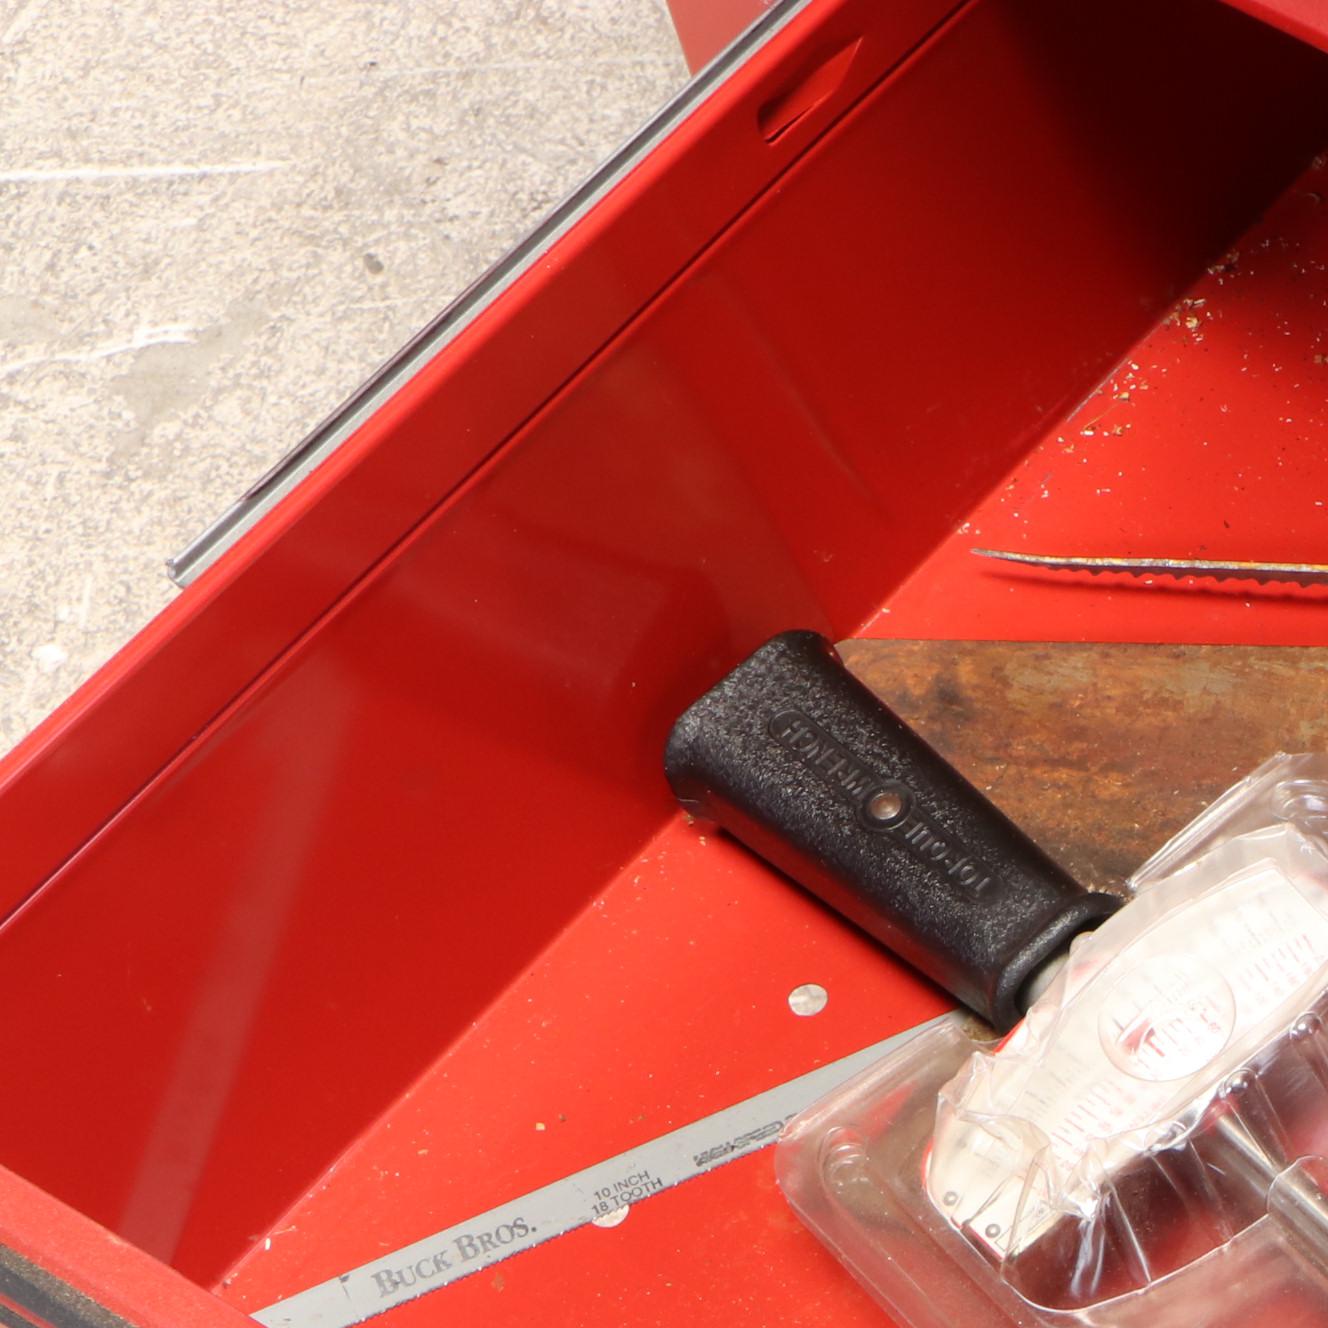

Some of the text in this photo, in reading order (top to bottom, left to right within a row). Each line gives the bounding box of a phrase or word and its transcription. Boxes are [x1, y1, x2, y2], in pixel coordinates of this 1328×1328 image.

[591, 1177, 664, 1216] 18 TOOTH
[593, 1169, 651, 1202] 10 INCH
